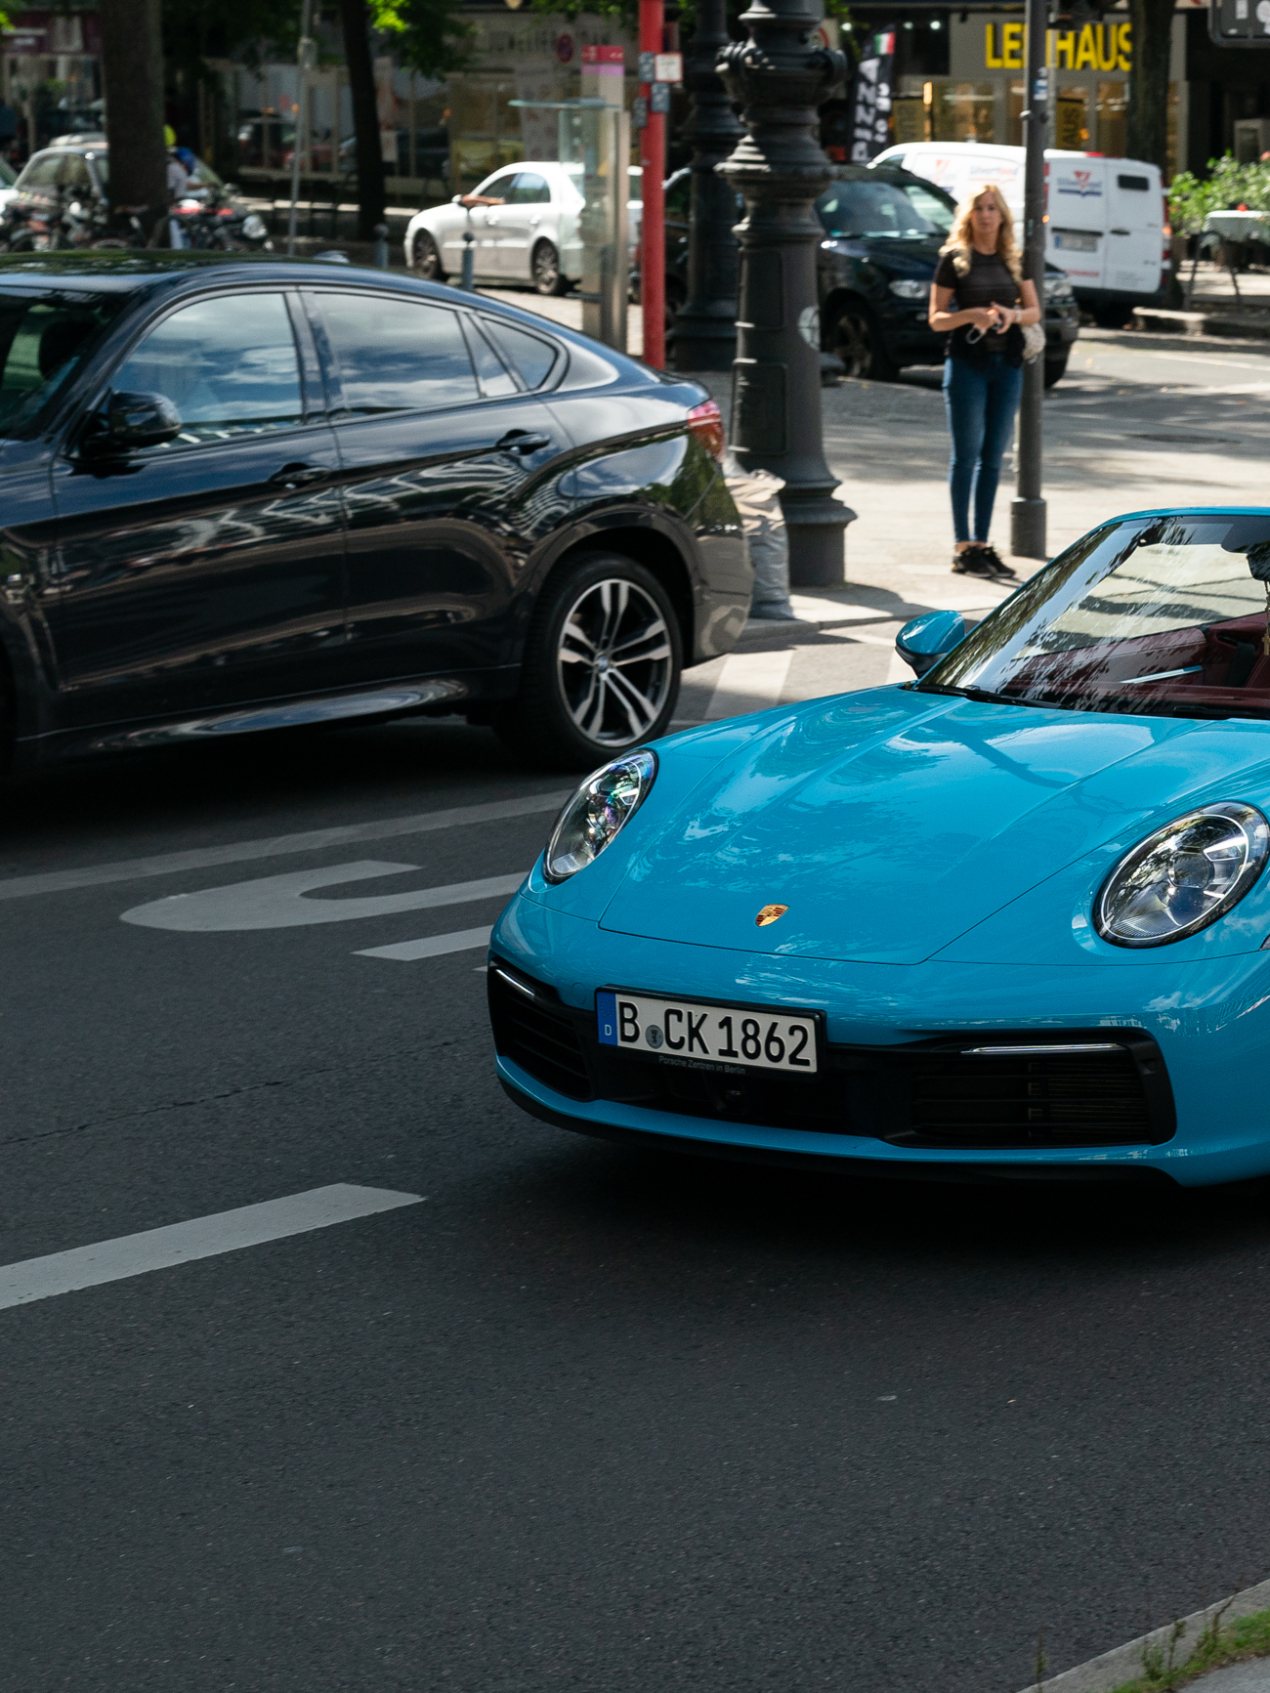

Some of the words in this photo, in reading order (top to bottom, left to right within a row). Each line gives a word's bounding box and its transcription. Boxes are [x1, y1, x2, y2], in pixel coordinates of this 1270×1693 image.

[851, 57, 881, 161] PIZZA
[604, 1024, 613, 1036] D
[618, 1001, 641, 1043] B
[664, 1008, 710, 1055] CK
[718, 1016, 811, 1067] 1862
[659, 1055, 687, 1067] Porsche
[688, 1060, 715, 1071] Zentren
[716, 1064, 723, 1072] in
[724, 1065, 746, 1075] Berlin
